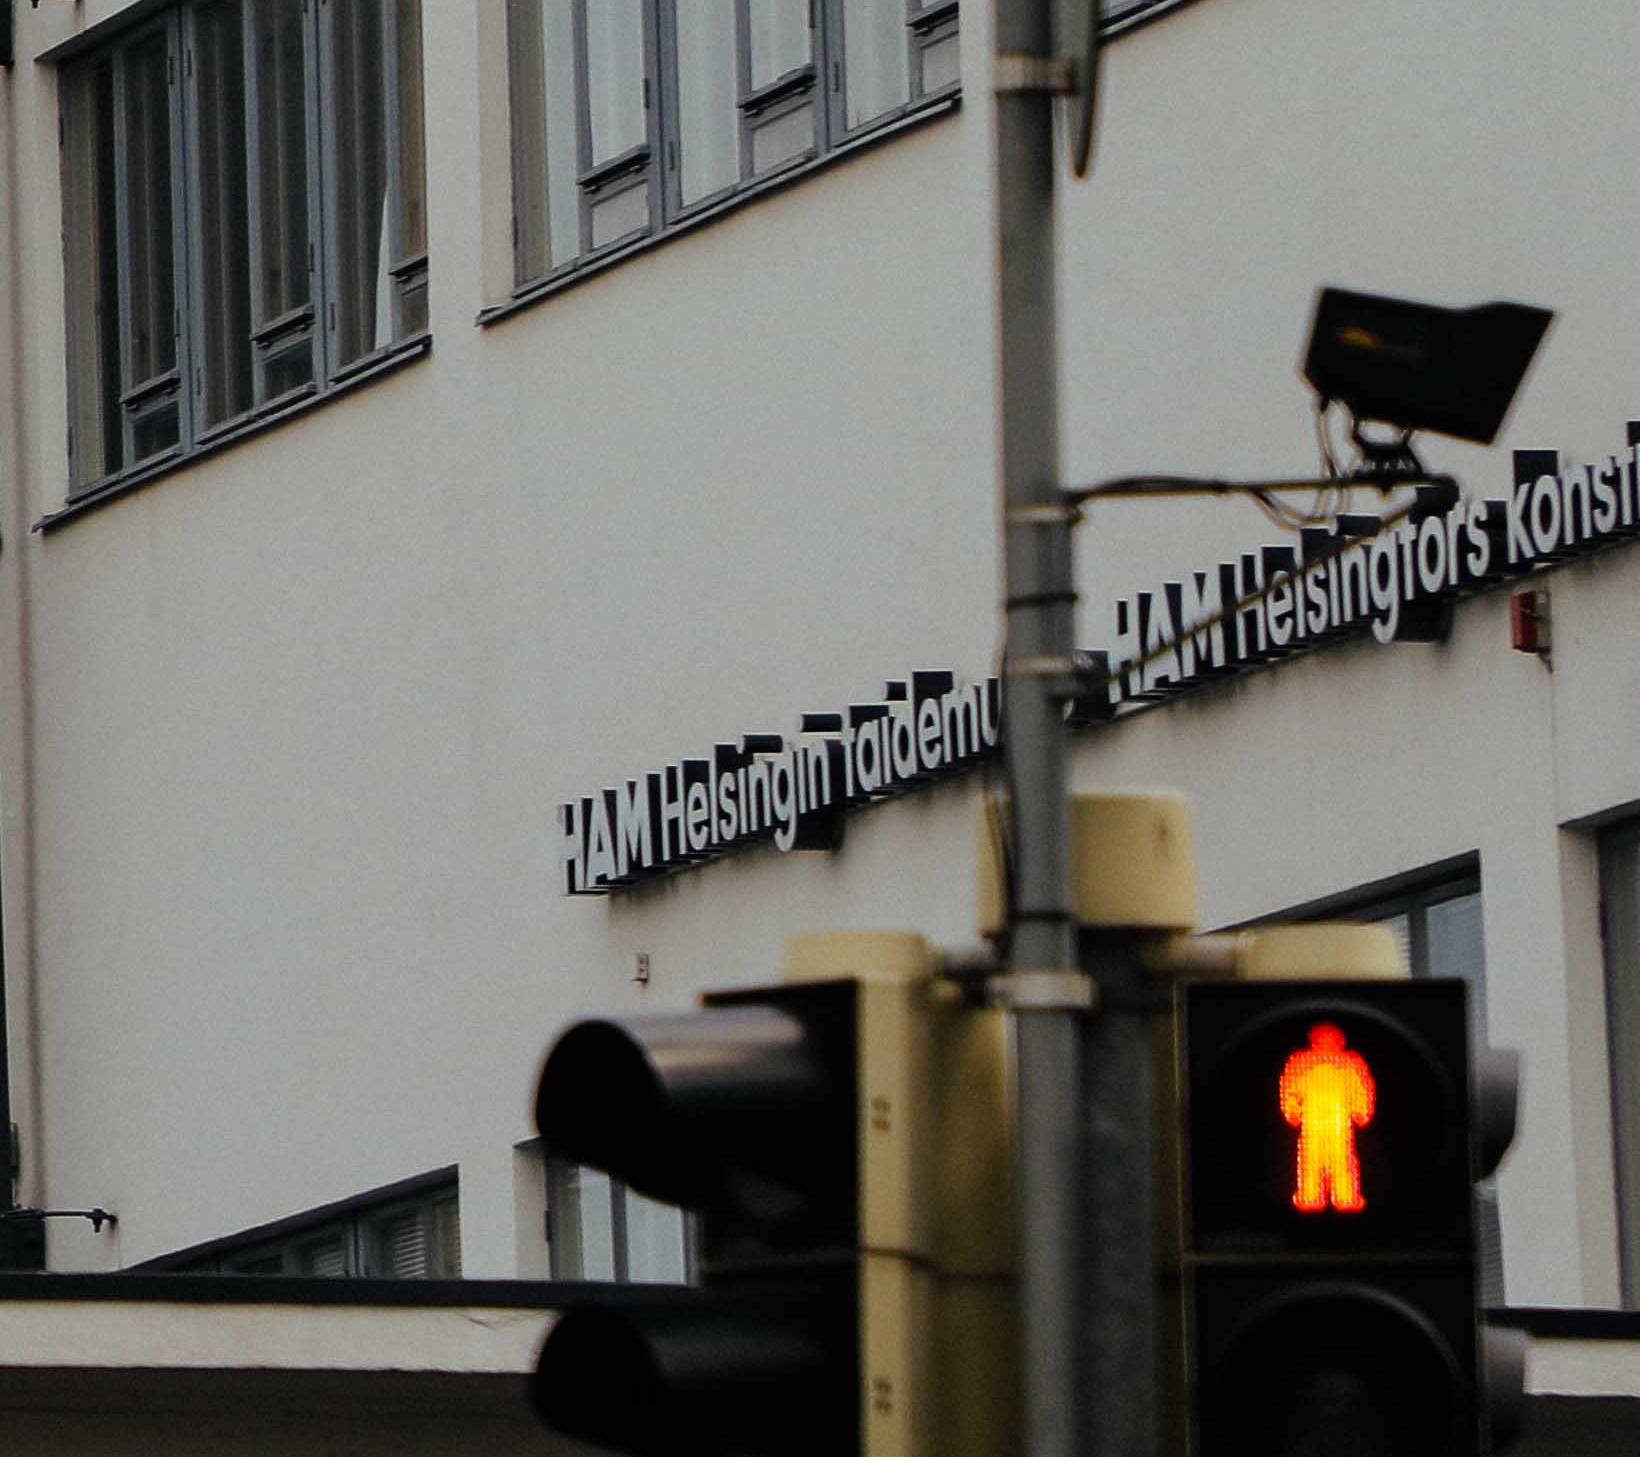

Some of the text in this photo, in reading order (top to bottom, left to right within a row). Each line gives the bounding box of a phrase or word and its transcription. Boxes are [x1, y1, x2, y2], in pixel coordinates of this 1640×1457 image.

[1107, 435, 1640, 705] HAM Helsingfors konst
[560, 667, 1002, 895] HAM Helsingin taidemu
